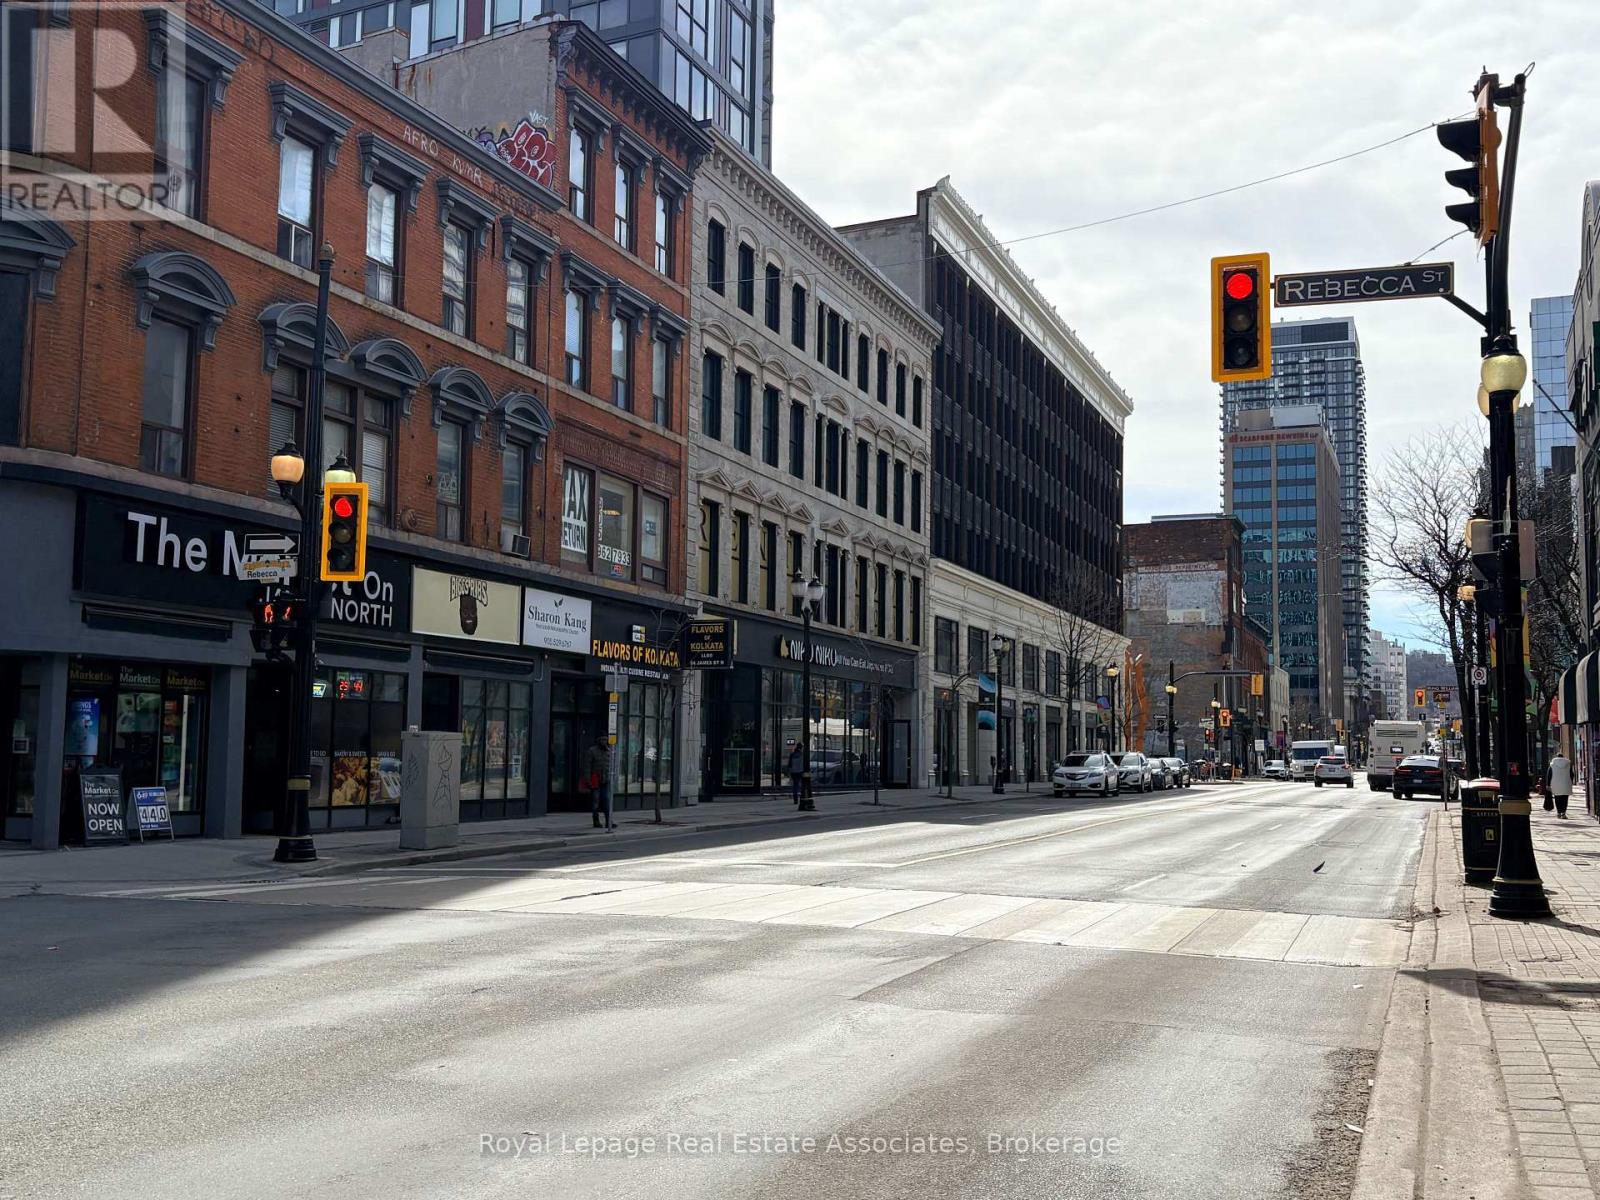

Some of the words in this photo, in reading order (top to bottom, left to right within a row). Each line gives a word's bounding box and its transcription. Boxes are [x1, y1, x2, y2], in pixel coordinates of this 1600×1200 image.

[402, 125, 438, 158] AFRO
[1284, 275, 1416, 301] REBECCA
[127, 511, 208, 572] The
[612, 549, 632, 566] 7933
[363, 571, 394, 603] On
[331, 597, 393, 627] NORTH
[528, 605, 561, 625] Sharon
[564, 612, 588, 633] Kang
[691, 625, 724, 634] FLAVORS
[592, 639, 631, 661] FLAVORS
[632, 645, 643, 663] OF
[690, 642, 724, 651] KOLKATA
[120, 673, 151, 685] Market
[84, 787, 112, 795] Market
[88, 803, 119, 816] NOW
[89, 819, 122, 832] OPEN
